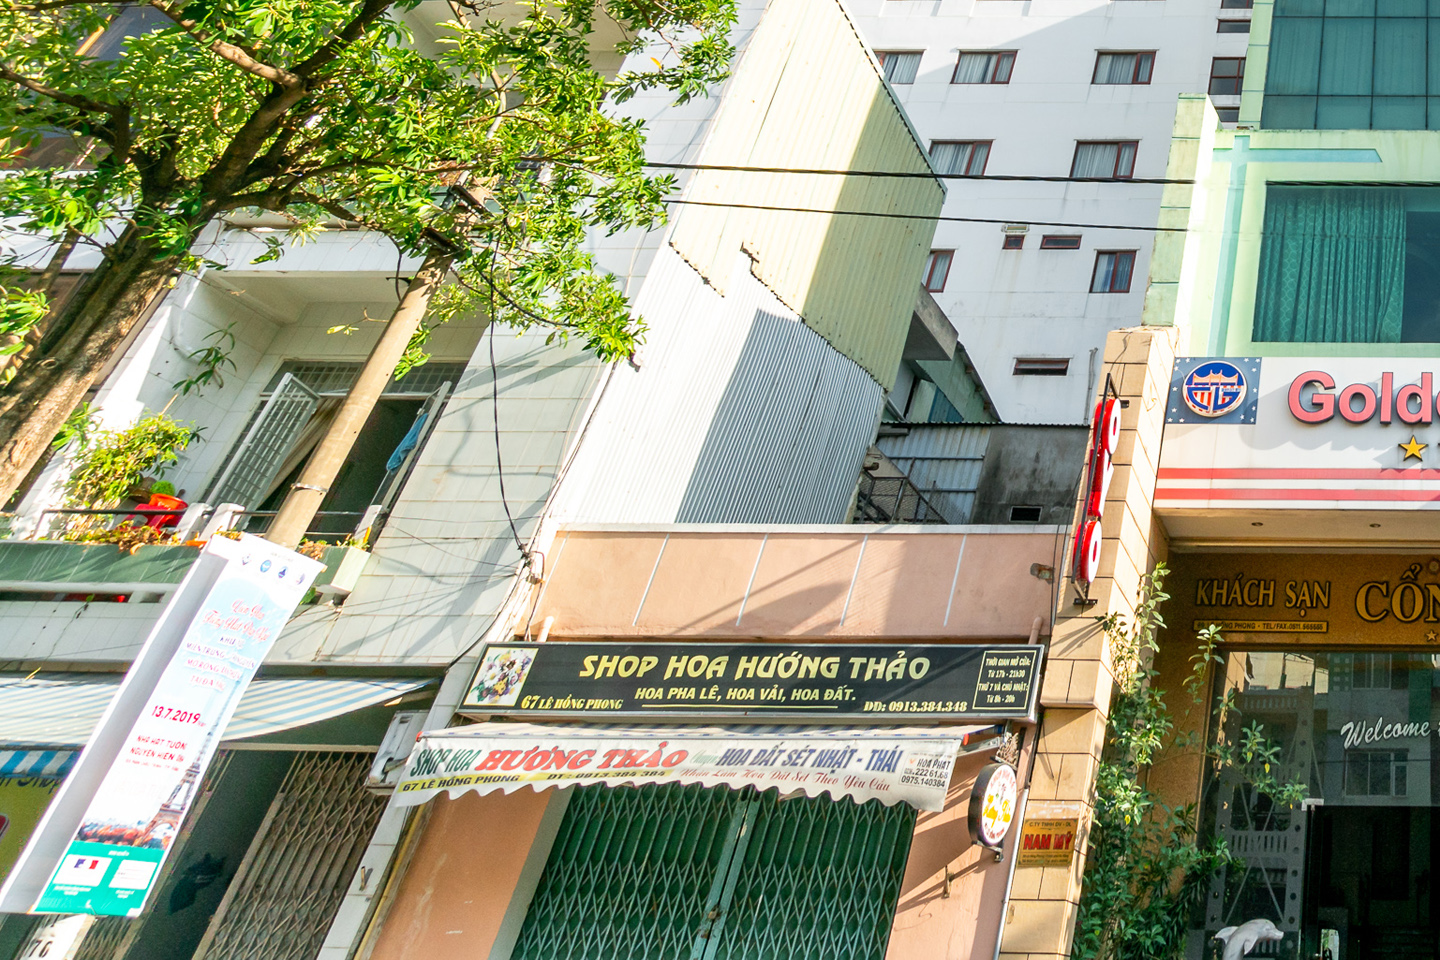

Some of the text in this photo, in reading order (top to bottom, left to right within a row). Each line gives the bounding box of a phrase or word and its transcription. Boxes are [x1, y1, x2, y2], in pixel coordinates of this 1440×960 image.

[1195, 572, 1277, 608] KHÁCH
[1284, 580, 1331, 618] SẠN
[1234, 622, 1256, 630] PHONG
[578, 654, 659, 680] SHOP
[663, 654, 730, 681] HOA
[848, 650, 931, 682] THẢO
[520, 695, 539, 710] 67
[537, 695, 554, 710] LÊ
[553, 693, 586, 710] HỒNG
[584, 698, 625, 710] PHONG
[634, 686, 665, 701] HOA
[666, 686, 697, 701] PHA
[725, 687, 756, 701] HOA
[790, 688, 821, 702] HOA
[151, 705, 202, 725] 13.7.2019
[1340, 716, 1431, 750] Welcome
[409, 748, 450, 778] SHOP
[446, 749, 480, 773] HOA
[474, 746, 593, 772] HƯƠNG
[596, 741, 689, 770] THẢO
[715, 748, 750, 767] HOA
[749, 742, 787, 768] ĐẤT
[783, 743, 815, 769] SÉT
[809, 744, 859, 775] NHẬT
[863, 744, 905, 774] THÁI
[402, 782, 419, 792] 67
[420, 779, 436, 790] LÊ
[473, 773, 521, 785] PHONG
[1023, 833, 1052, 850] NAM
